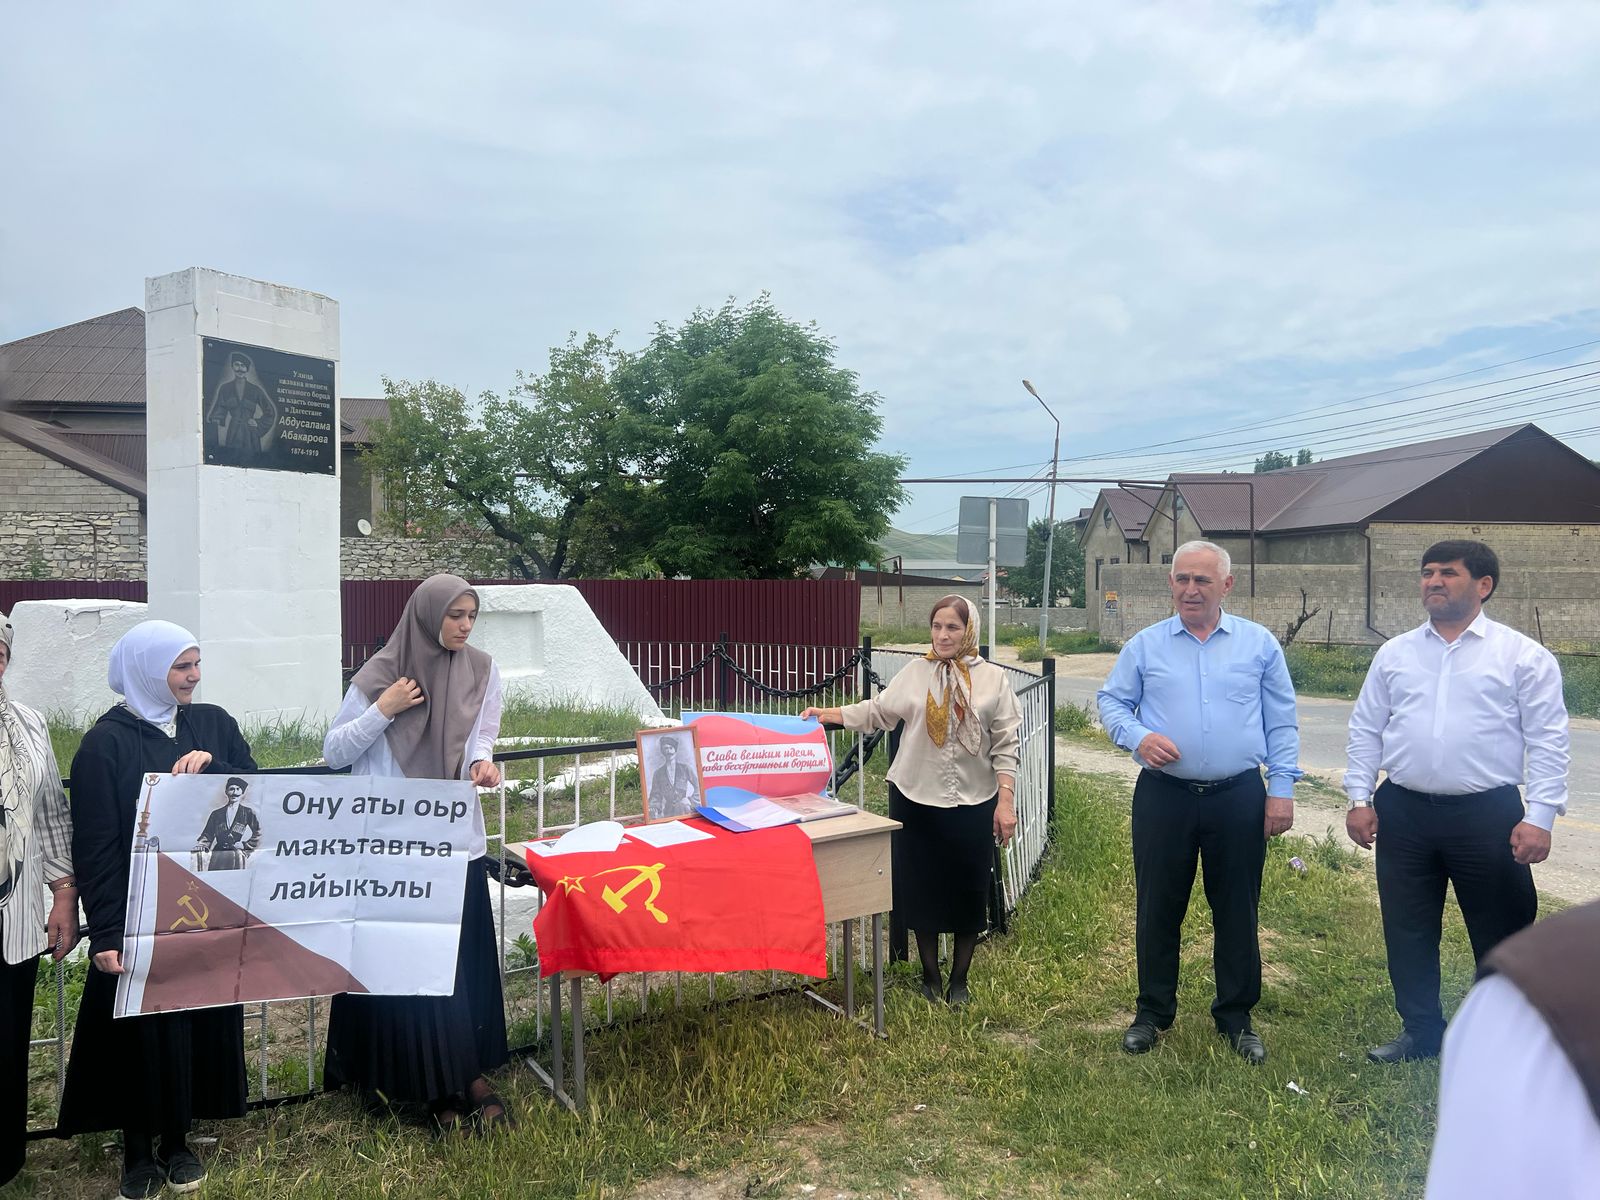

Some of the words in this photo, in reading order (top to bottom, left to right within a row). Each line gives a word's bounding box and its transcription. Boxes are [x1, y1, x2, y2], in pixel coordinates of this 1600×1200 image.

[293, 370, 313, 380] Улица
[279, 379, 304, 388] названа
[305, 382, 328, 390] именем
[312, 391, 330, 400] борца
[290, 406, 322, 416] Дагестане
[279, 416, 331, 430] Абдусалама
[280, 430, 328, 444] Абакарова
[291, 448, 320, 456] 1874-1919
[706, 750, 737, 762] Слава
[740, 749, 780, 760] великим
[784, 748, 816, 758] идеям,
[702, 762, 724, 772] лава
[724, 760, 789, 774] бесстрашным
[791, 758, 826, 772] борцам!
[282, 791, 344, 820] Ону
[351, 796, 404, 815] аты
[414, 799, 468, 823] оьр
[275, 838, 453, 857] макътавгъа
[270, 872, 432, 901] лайыкълы
